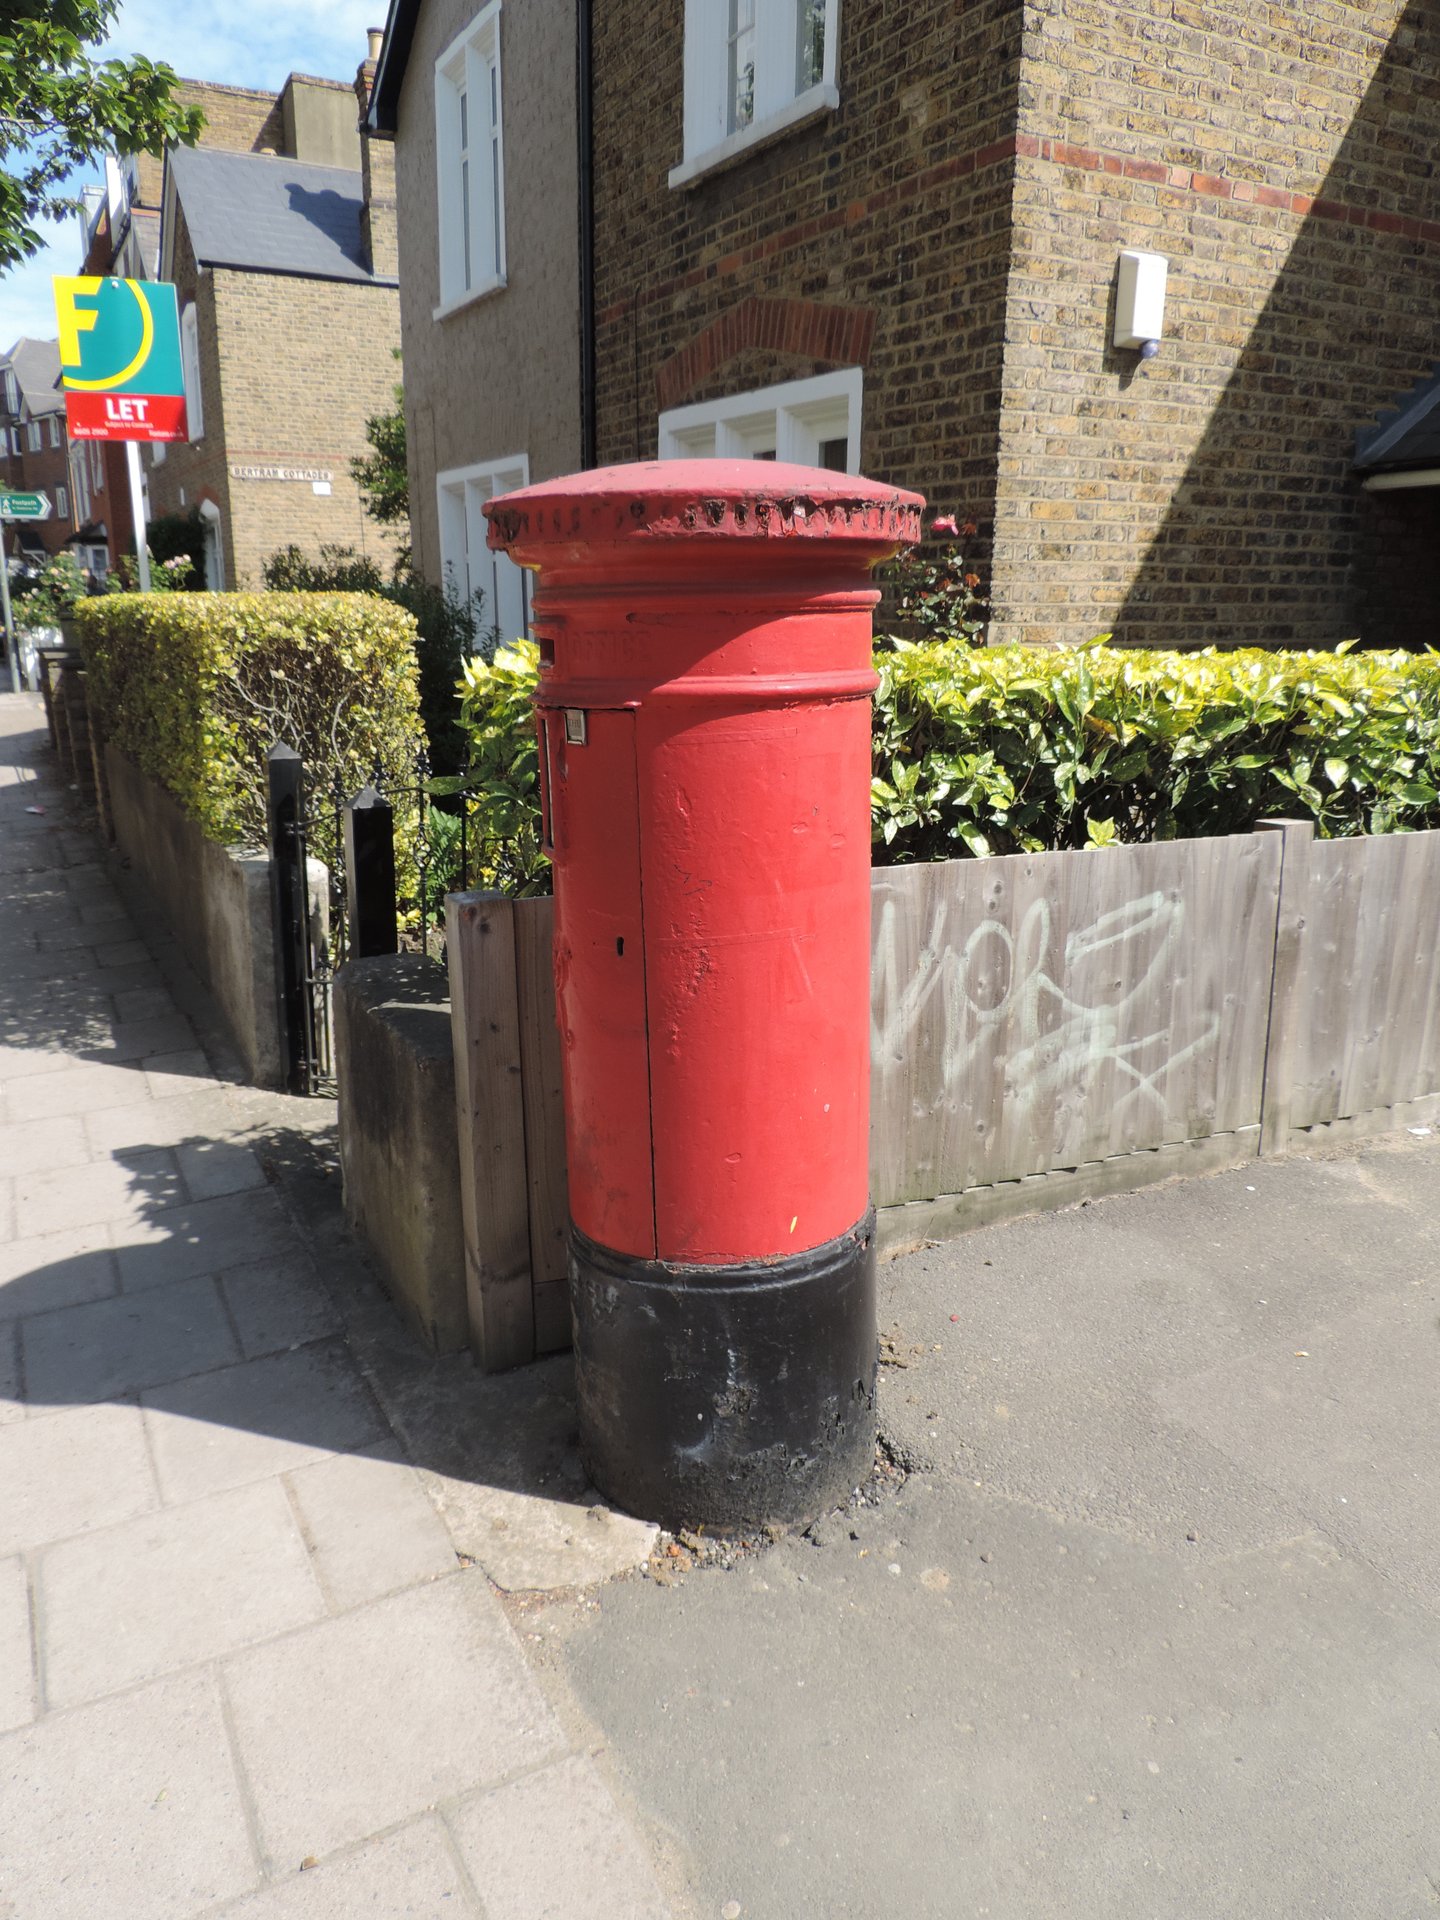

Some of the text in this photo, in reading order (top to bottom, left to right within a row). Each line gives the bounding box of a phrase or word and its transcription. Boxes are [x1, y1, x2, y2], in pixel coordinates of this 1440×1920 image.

[106, 398, 149, 421] LET
[234, 467, 329, 480] BERTRAM COTTAGES
